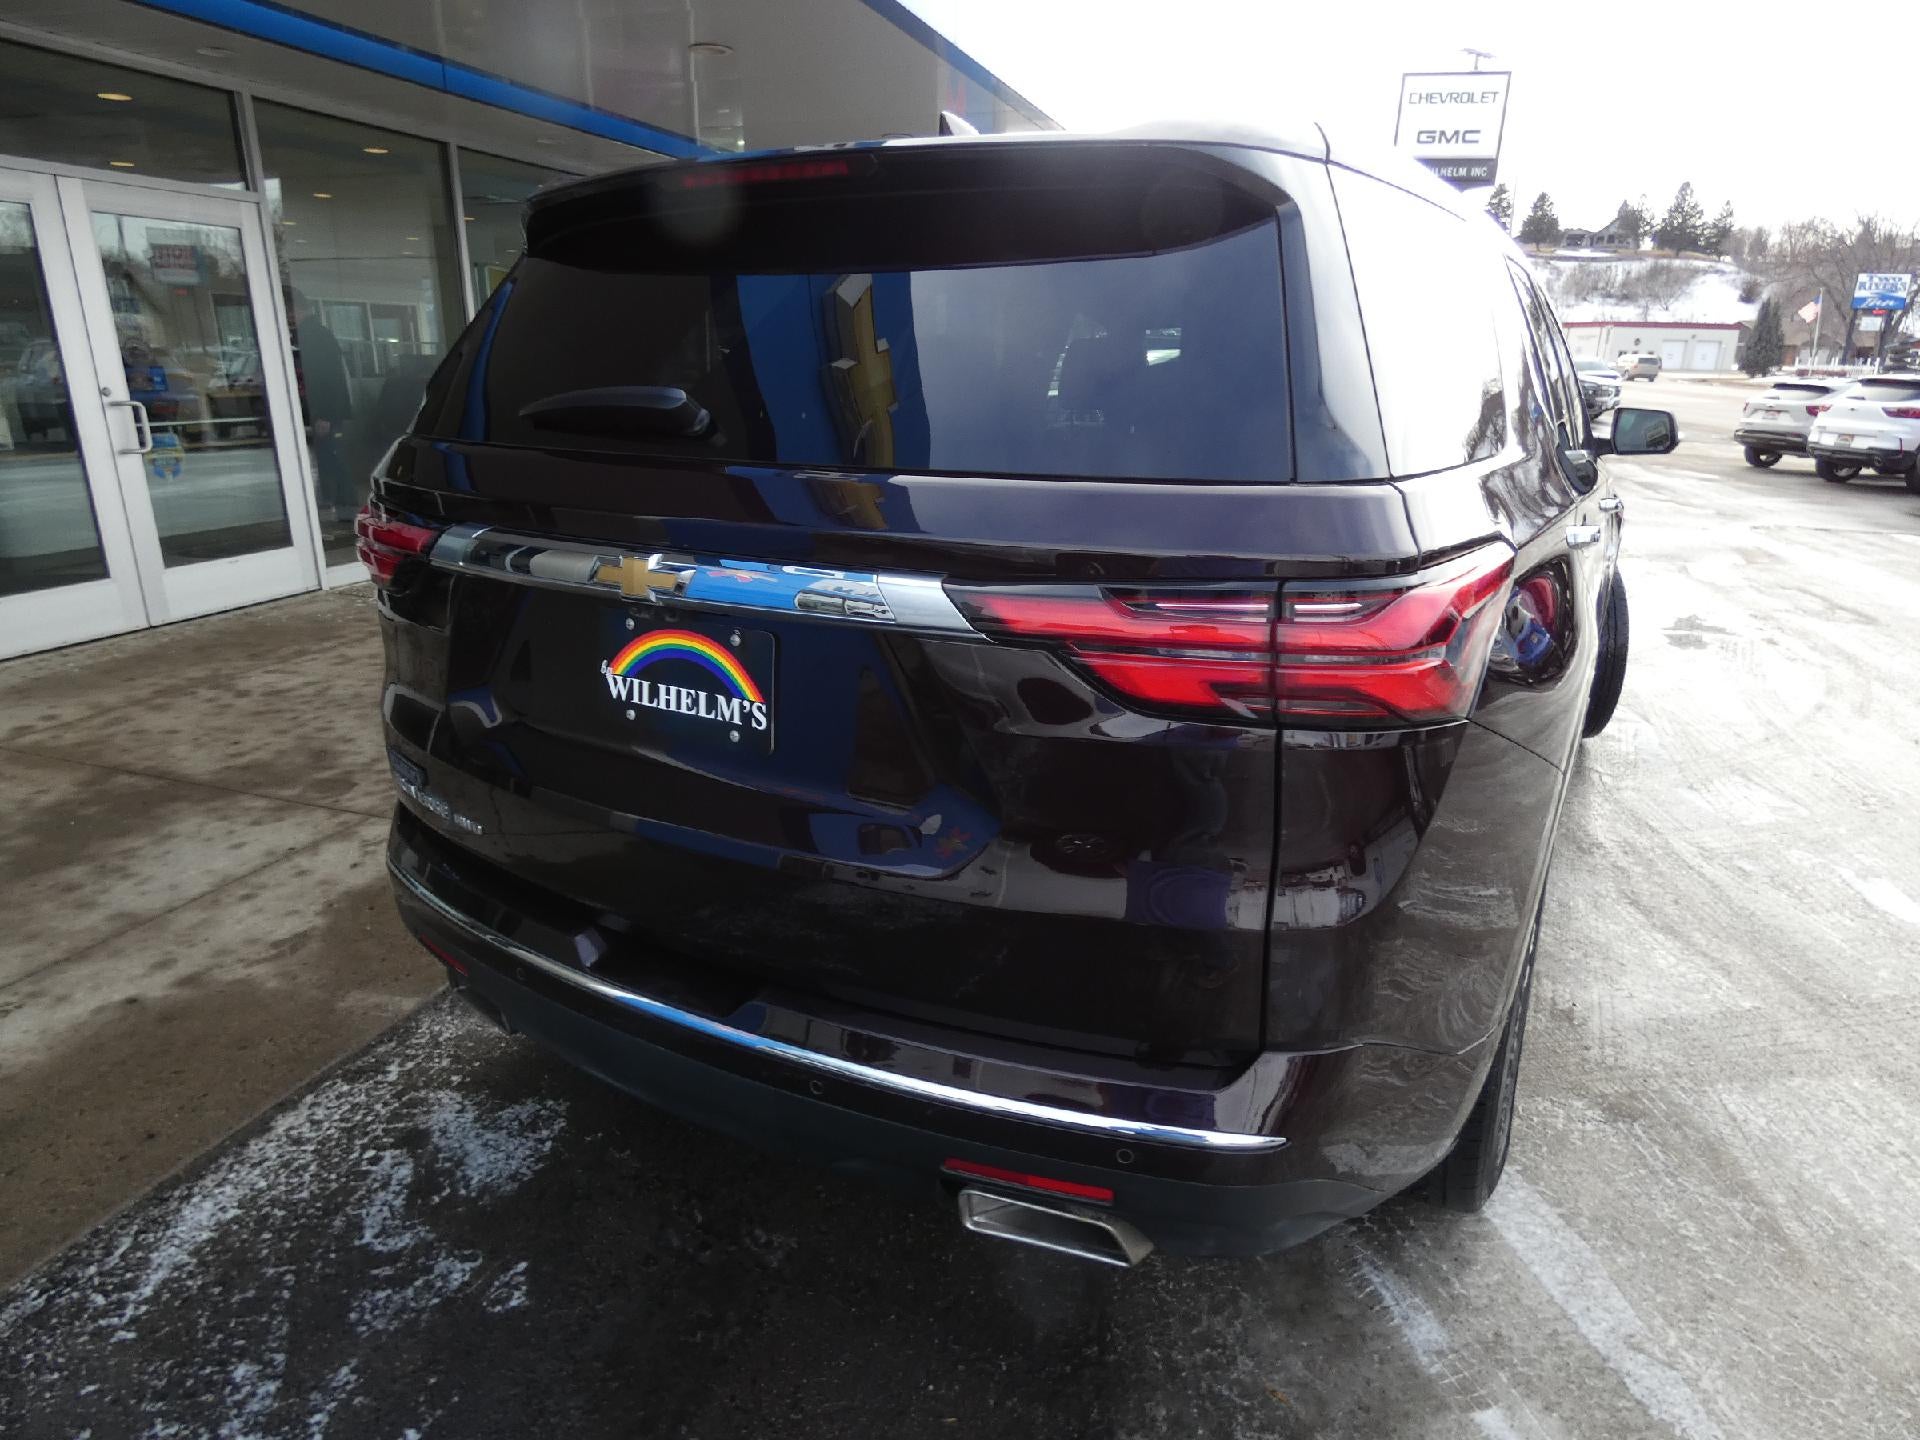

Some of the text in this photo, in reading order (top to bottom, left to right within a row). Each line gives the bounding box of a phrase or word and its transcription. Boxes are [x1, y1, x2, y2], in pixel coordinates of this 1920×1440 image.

[1408, 91, 1499, 105] CHEVROLET
[1416, 129, 1481, 144] GMC
[1430, 166, 1488, 177] ILHELM INC
[605, 674, 768, 730] WILHELM'S
